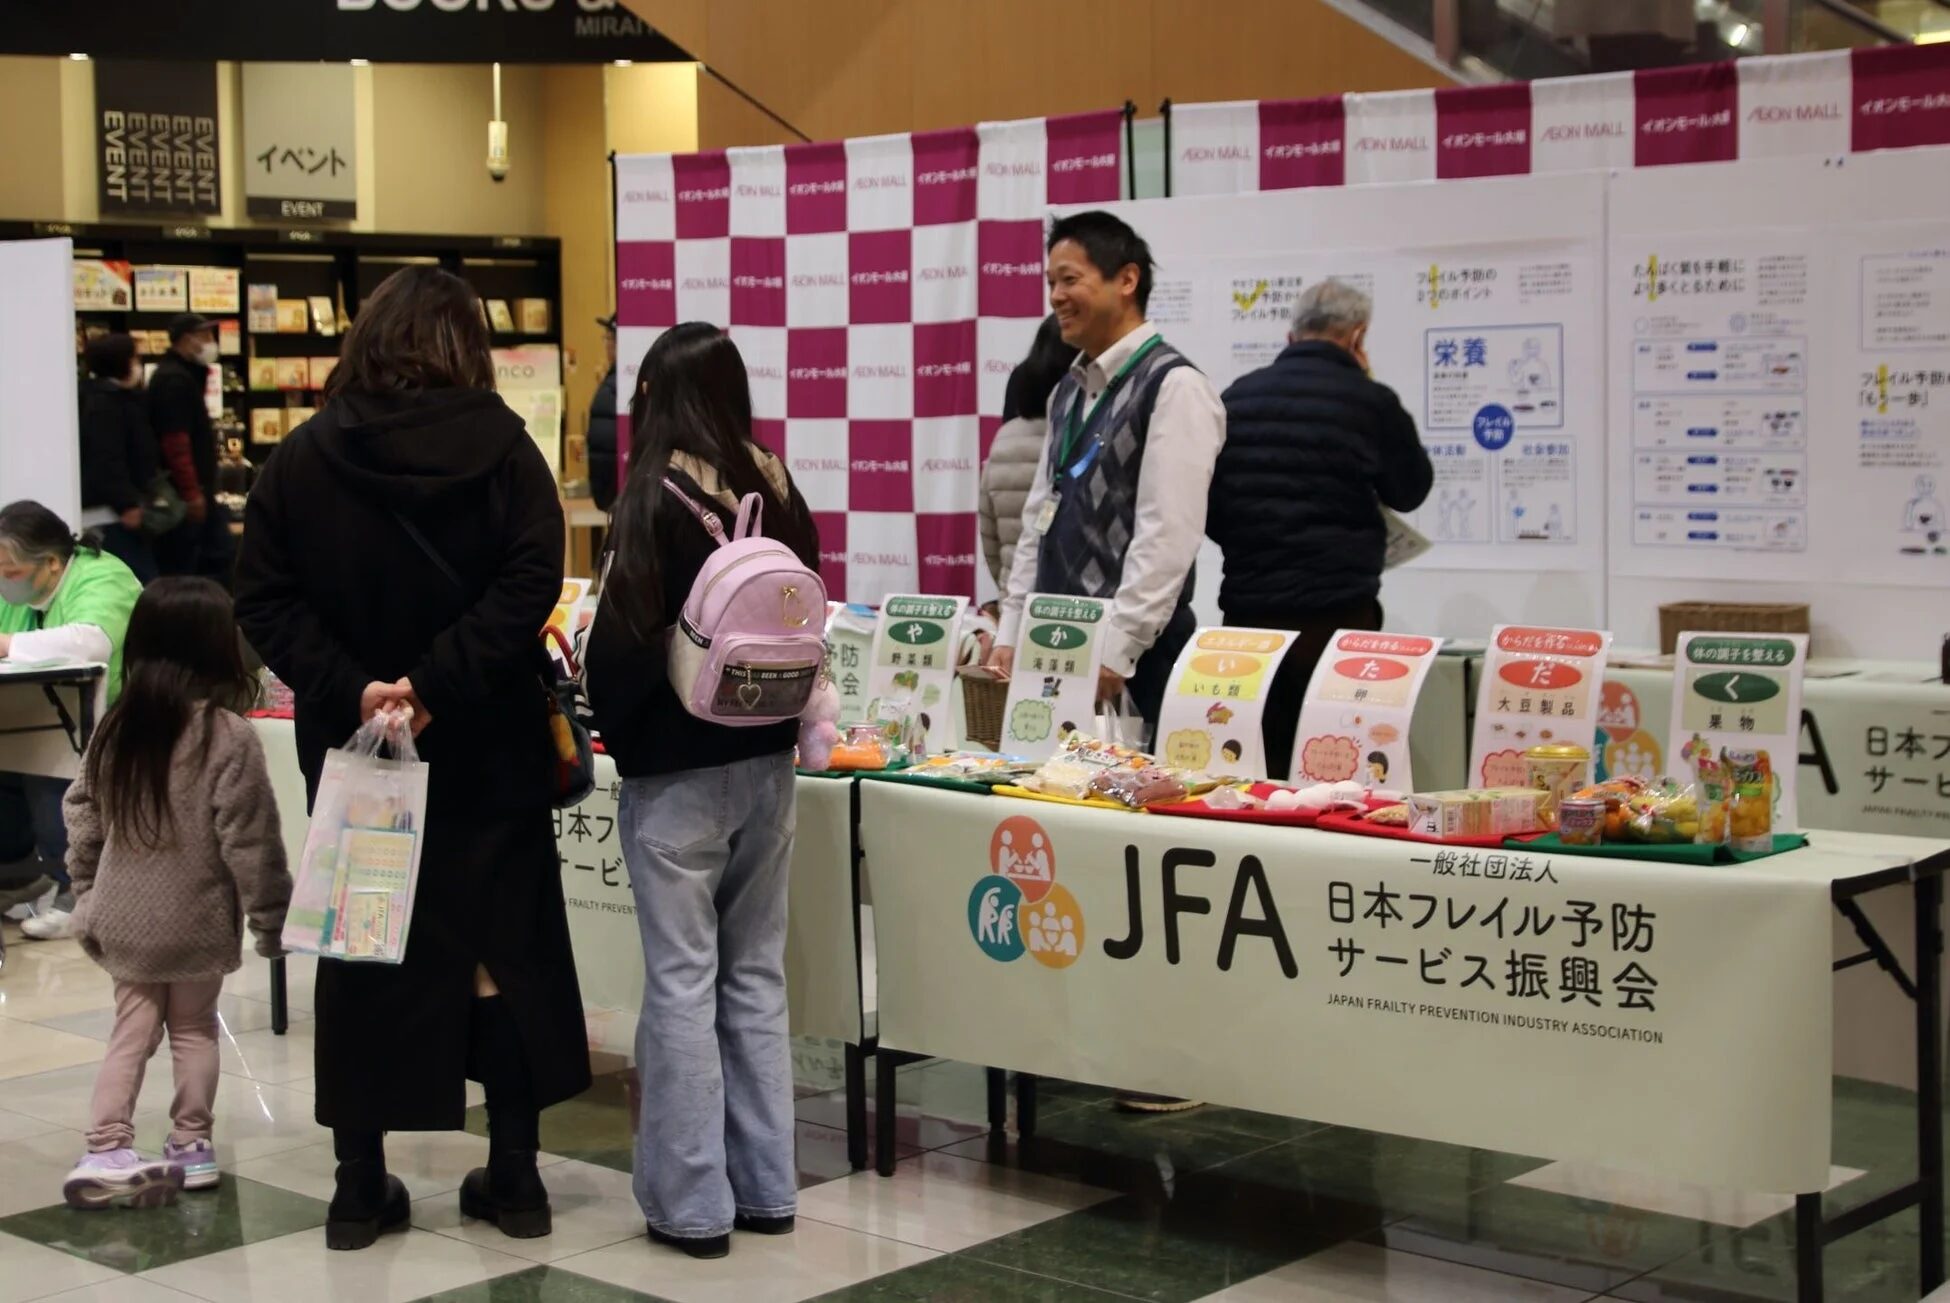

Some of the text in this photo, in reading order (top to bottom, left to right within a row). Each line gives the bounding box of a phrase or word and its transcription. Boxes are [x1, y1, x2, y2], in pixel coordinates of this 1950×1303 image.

[104, 111, 127, 202] EVENT
[127, 113, 149, 202] EVENT
[150, 114, 172, 204] EVENT
[172, 116, 195, 205] EVENT
[195, 117, 216, 206] EVENT
[257, 145, 346, 177] イベント
[281, 201, 323, 217] EVENT
[1434, 337, 1488, 367] 栄養
[907, 622, 924, 643] や
[1049, 626, 1068, 648] か
[891, 652, 934, 667] 野菜類
[1218, 658, 1236, 673] い
[1692, 646, 1786, 663] 体の調子を整える
[731, 668, 747, 678] THIS
[782, 671, 800, 679] GOOD
[1359, 658, 1382, 679] た
[1530, 661, 1557, 685] だ
[1194, 683, 1242, 697] いも類
[1354, 688, 1368, 701] 卵
[1723, 674, 1740, 701] く
[1497, 696, 1576, 716] 大豆製品
[1708, 713, 1756, 732] 果物
[1409, 850, 1560, 884] 一般社団法人
[569, 897, 600, 912] FRAILTY
[1102, 844, 1300, 980] JFA
[1328, 881, 1657, 953] 日本フレイル予防
[1327, 937, 1658, 1013] サービス振興会
[1327, 992, 1664, 1045] JAPAN FRAILTY PREVENTION INDUSTRY ASSOCIATION
